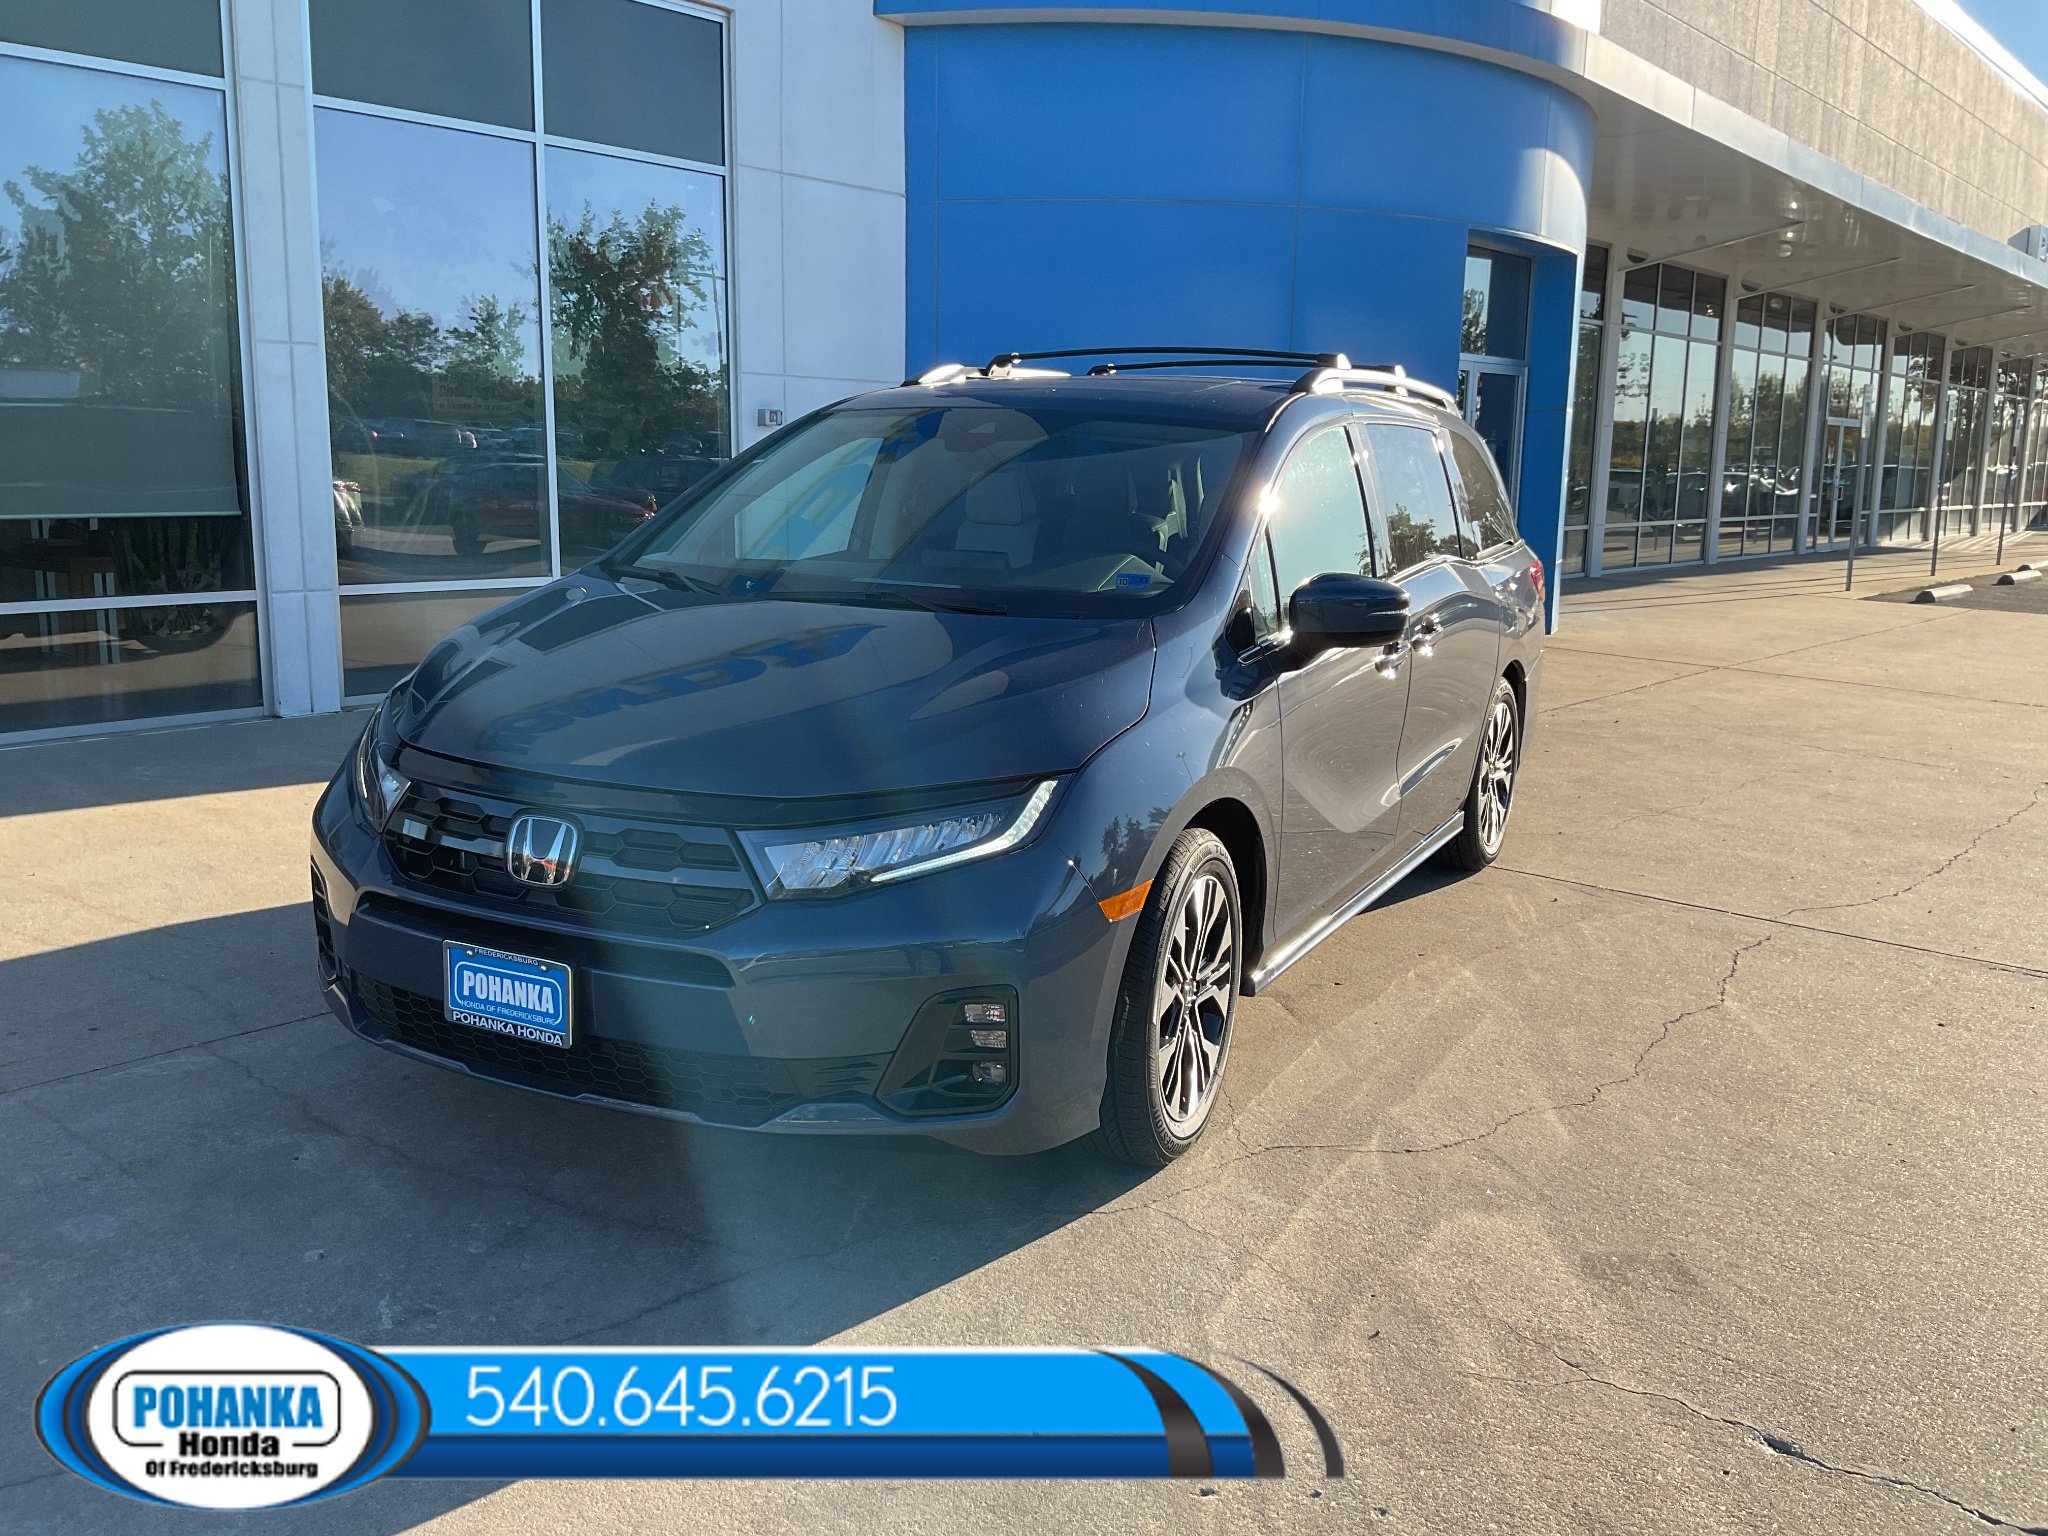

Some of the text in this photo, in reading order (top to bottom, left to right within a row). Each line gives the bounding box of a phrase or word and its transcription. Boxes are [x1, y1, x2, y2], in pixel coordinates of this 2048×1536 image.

[474, 948, 539, 966] FREDERICKSBURG
[463, 970, 554, 1014] POHANKA
[452, 1010, 563, 1046] POHANKA HONDA
[462, 1000, 485, 1011] HONDA
[497, 1006, 557, 1026] FREDERICKSBURG
